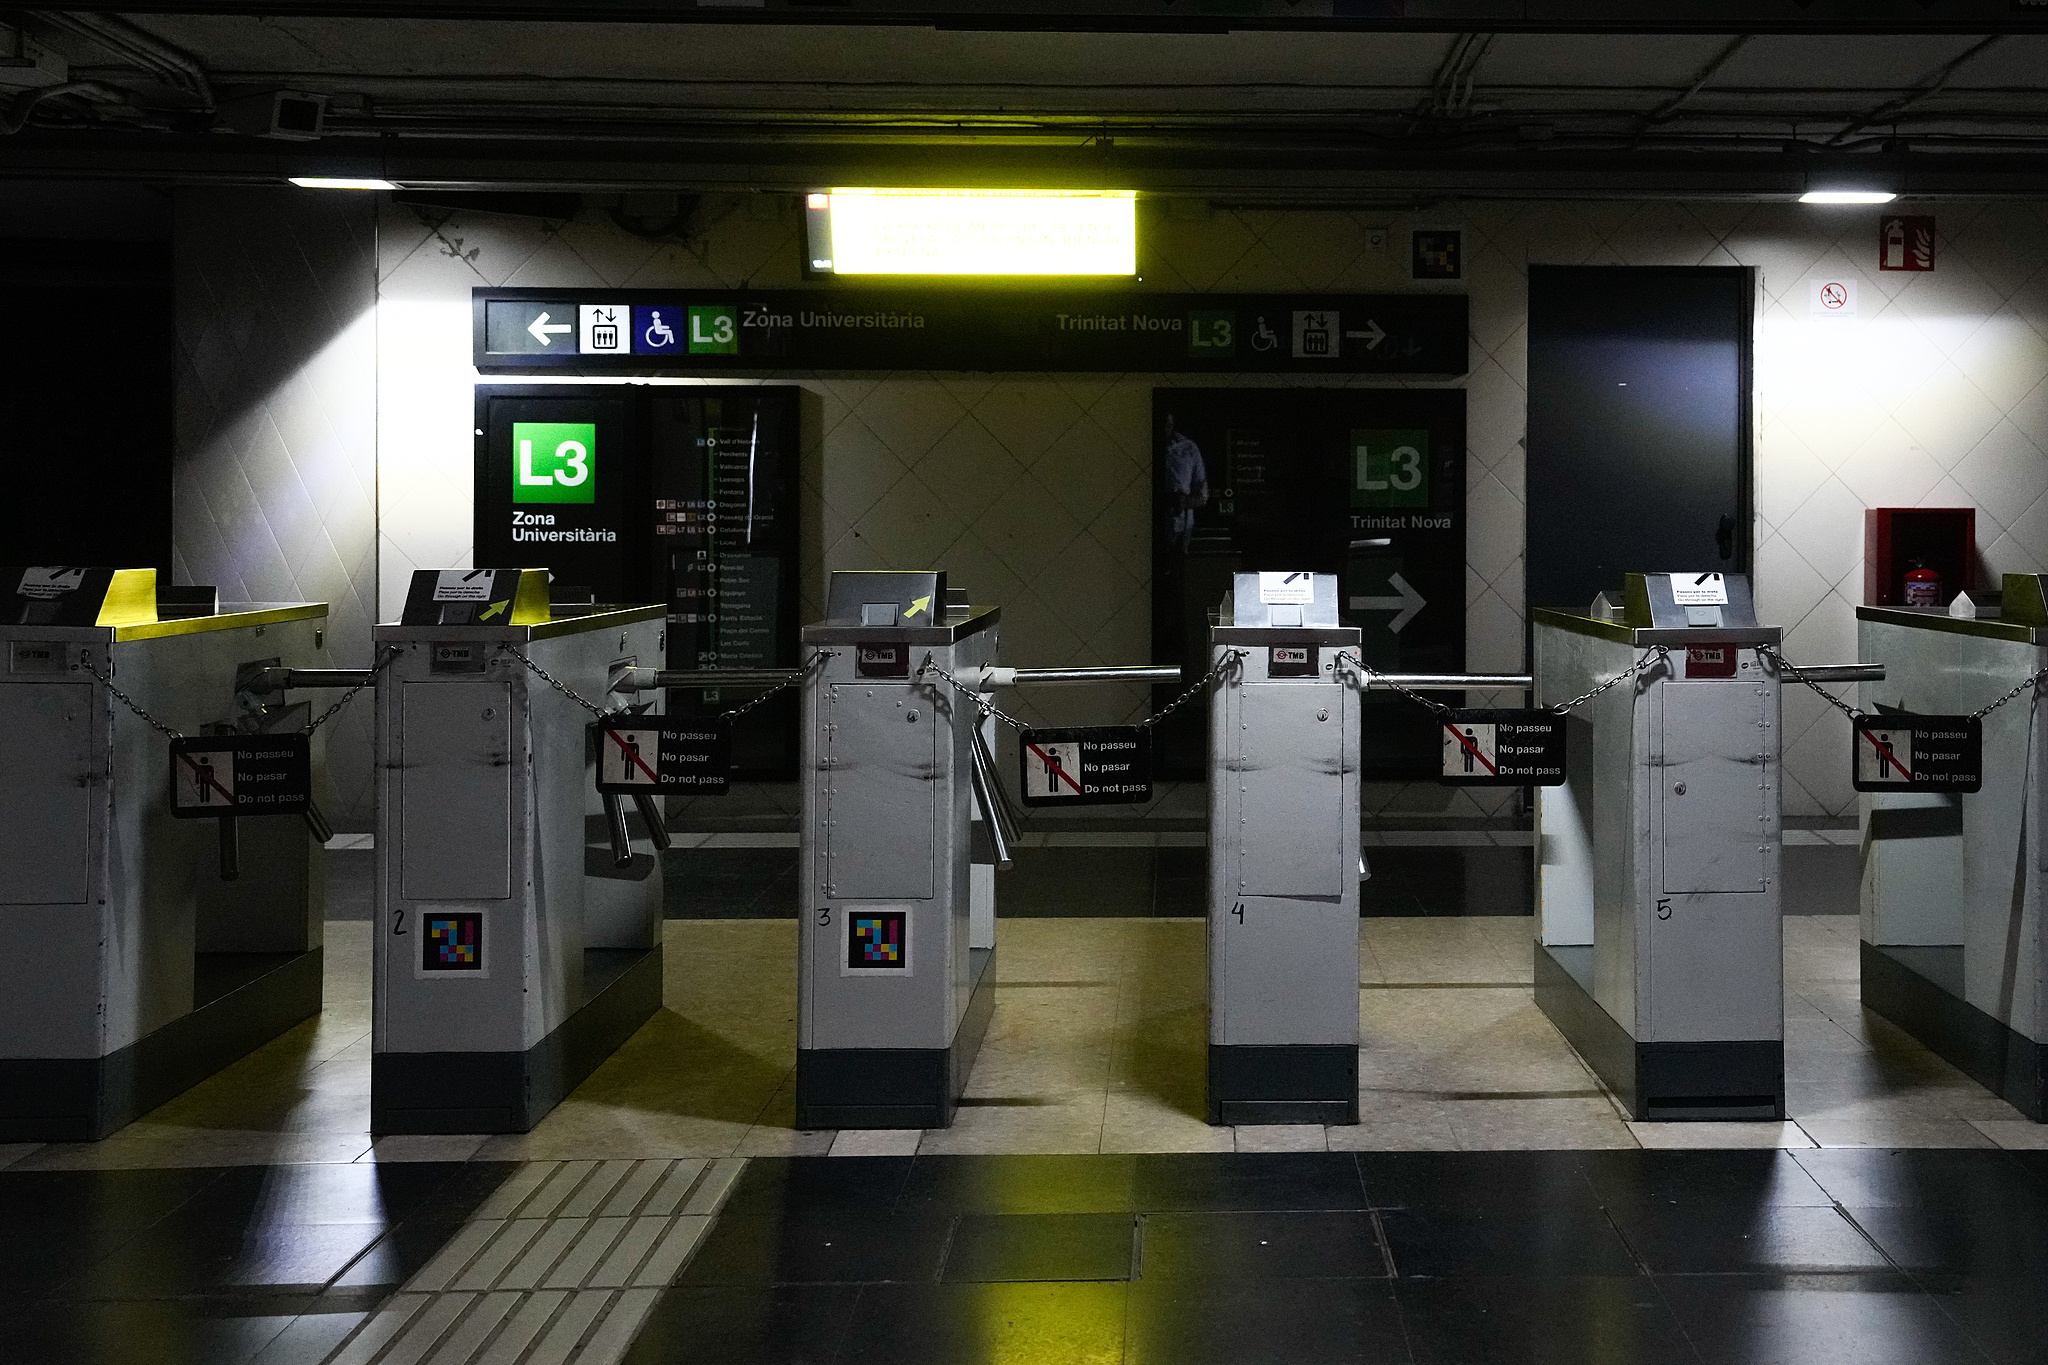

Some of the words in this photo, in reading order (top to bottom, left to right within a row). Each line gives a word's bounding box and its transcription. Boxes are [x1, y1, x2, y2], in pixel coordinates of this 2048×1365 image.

[743, 308, 792, 327] Zona
[801, 311, 924, 328] Universitària
[1056, 314, 1125, 330] Trinitat
[1133, 315, 1181, 330] Nova
[693, 316, 733, 342] L3
[1192, 320, 1231, 347] L3
[517, 439, 587, 486] L3
[1357, 446, 1421, 490] L3
[1219, 503, 1234, 513] L3
[513, 512, 554, 525] Zona
[1351, 516, 1406, 528] Trinitat
[1412, 516, 1450, 528] Nova
[513, 528, 615, 541] Universitària
[1500, 724, 1513, 732] No
[1517, 724, 1551, 735] passeu
[663, 731, 676, 739] No
[680, 732, 716, 742] passeu
[1916, 730, 1928, 738] No
[1932, 731, 1967, 741] passeu
[1084, 742, 1097, 750] No
[1101, 741, 1135, 752] passeu
[1500, 745, 1513, 753] No
[1517, 746, 1543, 756] pasar
[238, 751, 252, 759] No
[255, 749, 293, 761] passeu
[662, 753, 676, 761] No
[680, 754, 708, 764] pasar
[1916, 751, 1928, 759] No
[1933, 752, 1960, 762] pasar
[1102, 763, 1130, 774] pasar
[1500, 766, 1513, 774] Do
[1537, 767, 1560, 776] pass
[239, 773, 253, 781] No
[257, 772, 287, 783] pasar
[661, 774, 675, 782] Do
[700, 776, 724, 785] pass
[1915, 772, 1929, 780] Do
[1952, 773, 1976, 783] pass
[1085, 785, 1099, 793] Do
[1103, 784, 1119, 792] not
[1123, 783, 1146, 794] pass
[239, 795, 253, 803] Do
[279, 794, 304, 805] pass
[1232, 902, 1244, 924] 4
[1657, 898, 1672, 920] 5
[394, 910, 407, 935] 2
[818, 908, 830, 926] 3
